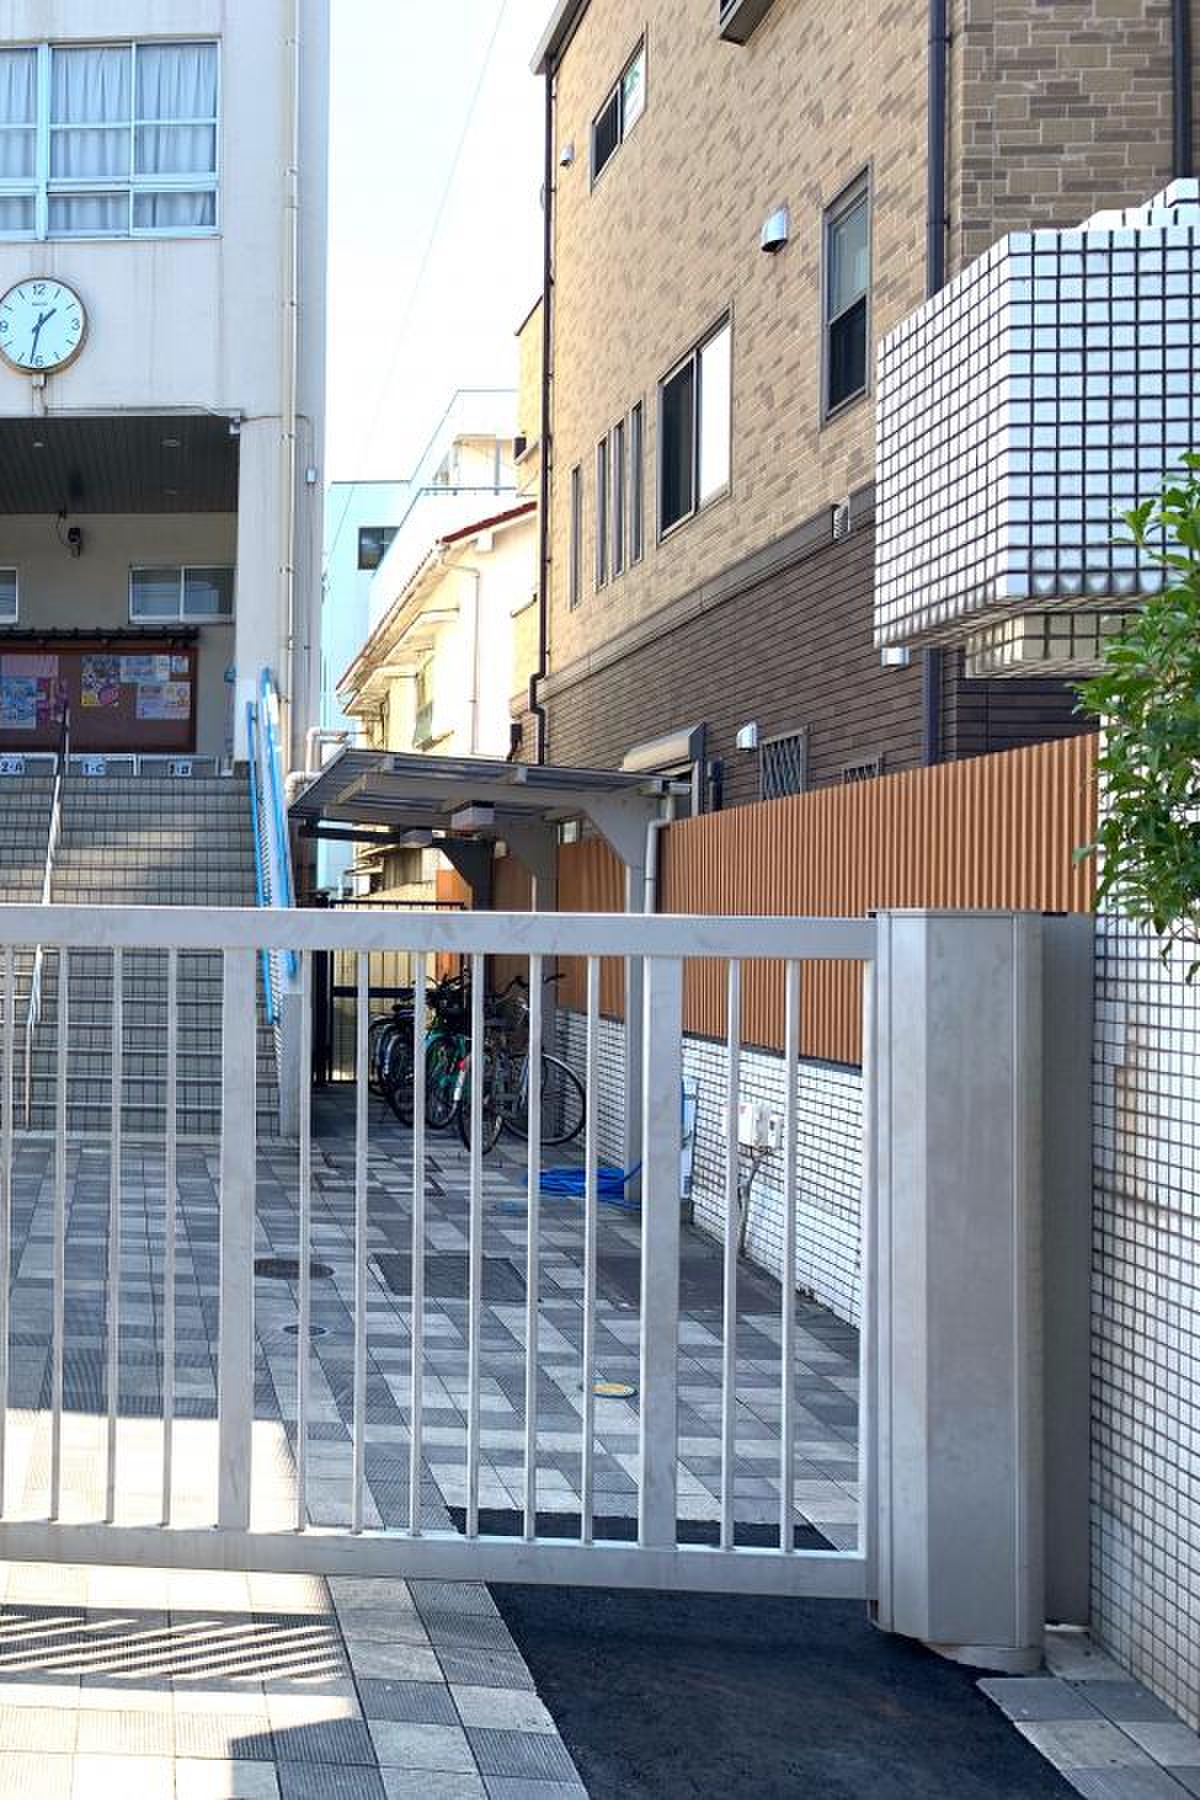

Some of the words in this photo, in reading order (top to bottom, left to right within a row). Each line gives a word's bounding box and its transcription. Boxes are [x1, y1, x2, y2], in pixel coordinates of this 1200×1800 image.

[32, 283, 47, 295] 12
[71, 318, 81, 331] 3
[35, 355, 44, 367] 6
